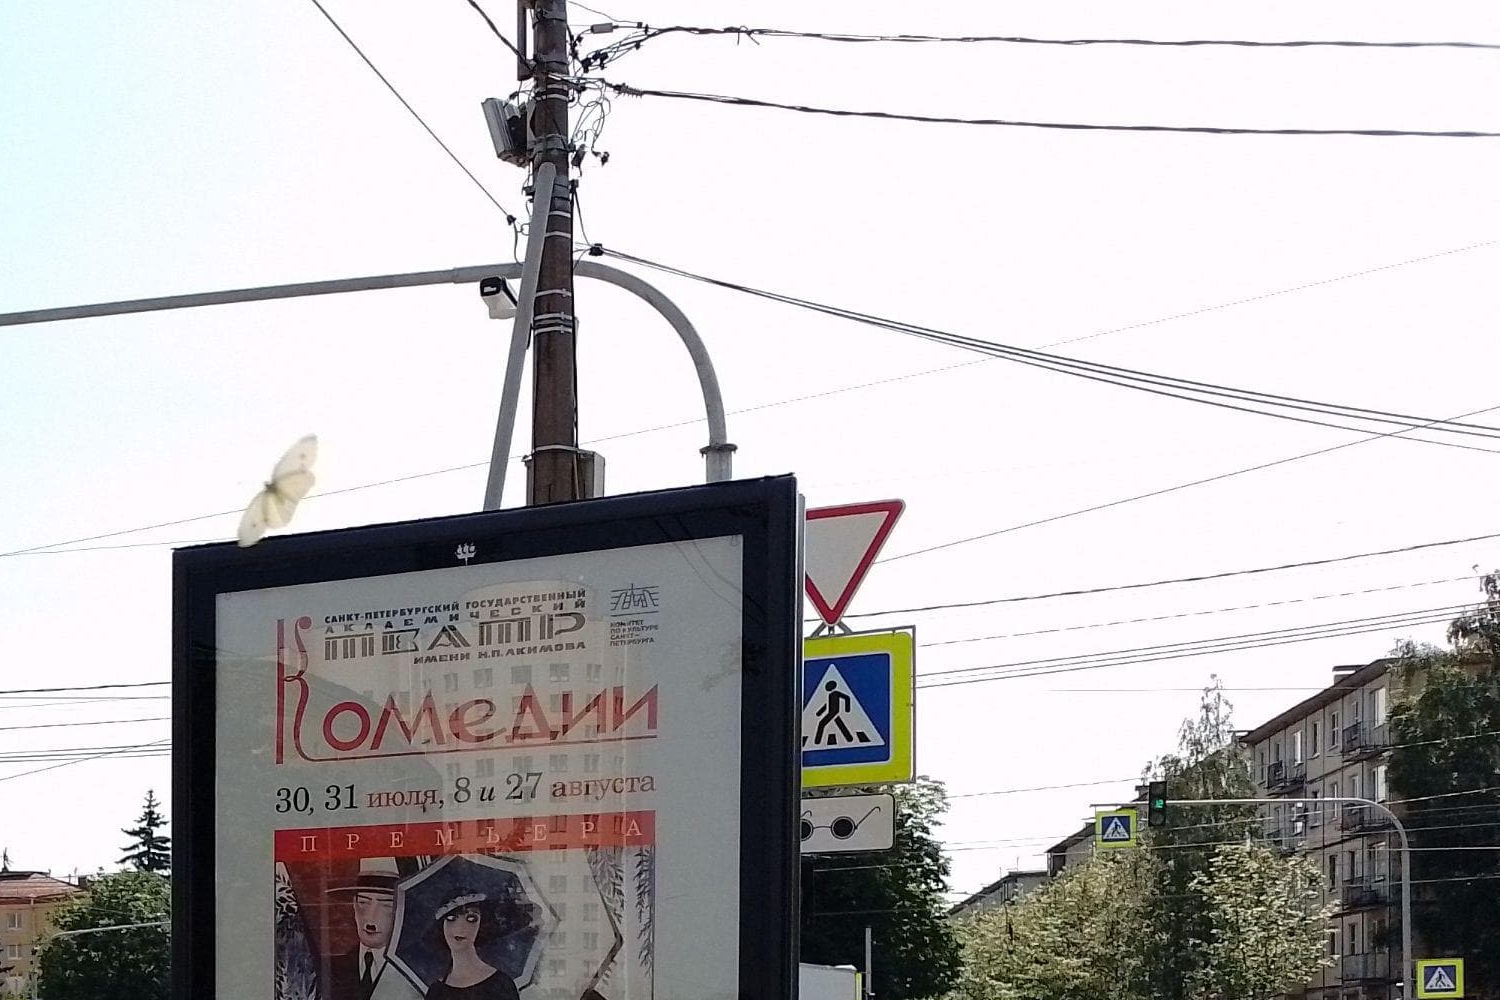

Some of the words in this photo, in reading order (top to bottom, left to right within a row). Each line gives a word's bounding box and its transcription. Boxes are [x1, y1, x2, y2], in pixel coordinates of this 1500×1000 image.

[324, 601, 460, 624] САНКТ-ПЕТЕРБУРГСКИЙ
[465, 588, 586, 610] ГОСУДАРСТВЕННЫЙ
[324, 612, 586, 661] ТЕАТР
[413, 652, 470, 665] ИМЕНИ
[275, 787, 315, 816] 30,
[324, 783, 359, 811] 31
[367, 788, 445, 813] июля,
[453, 776, 472, 804] 8
[479, 784, 496, 803] и
[505, 771, 544, 801] 27
[552, 774, 656, 801] августа
[300, 818, 643, 853] ПРЕМЬЕРА
